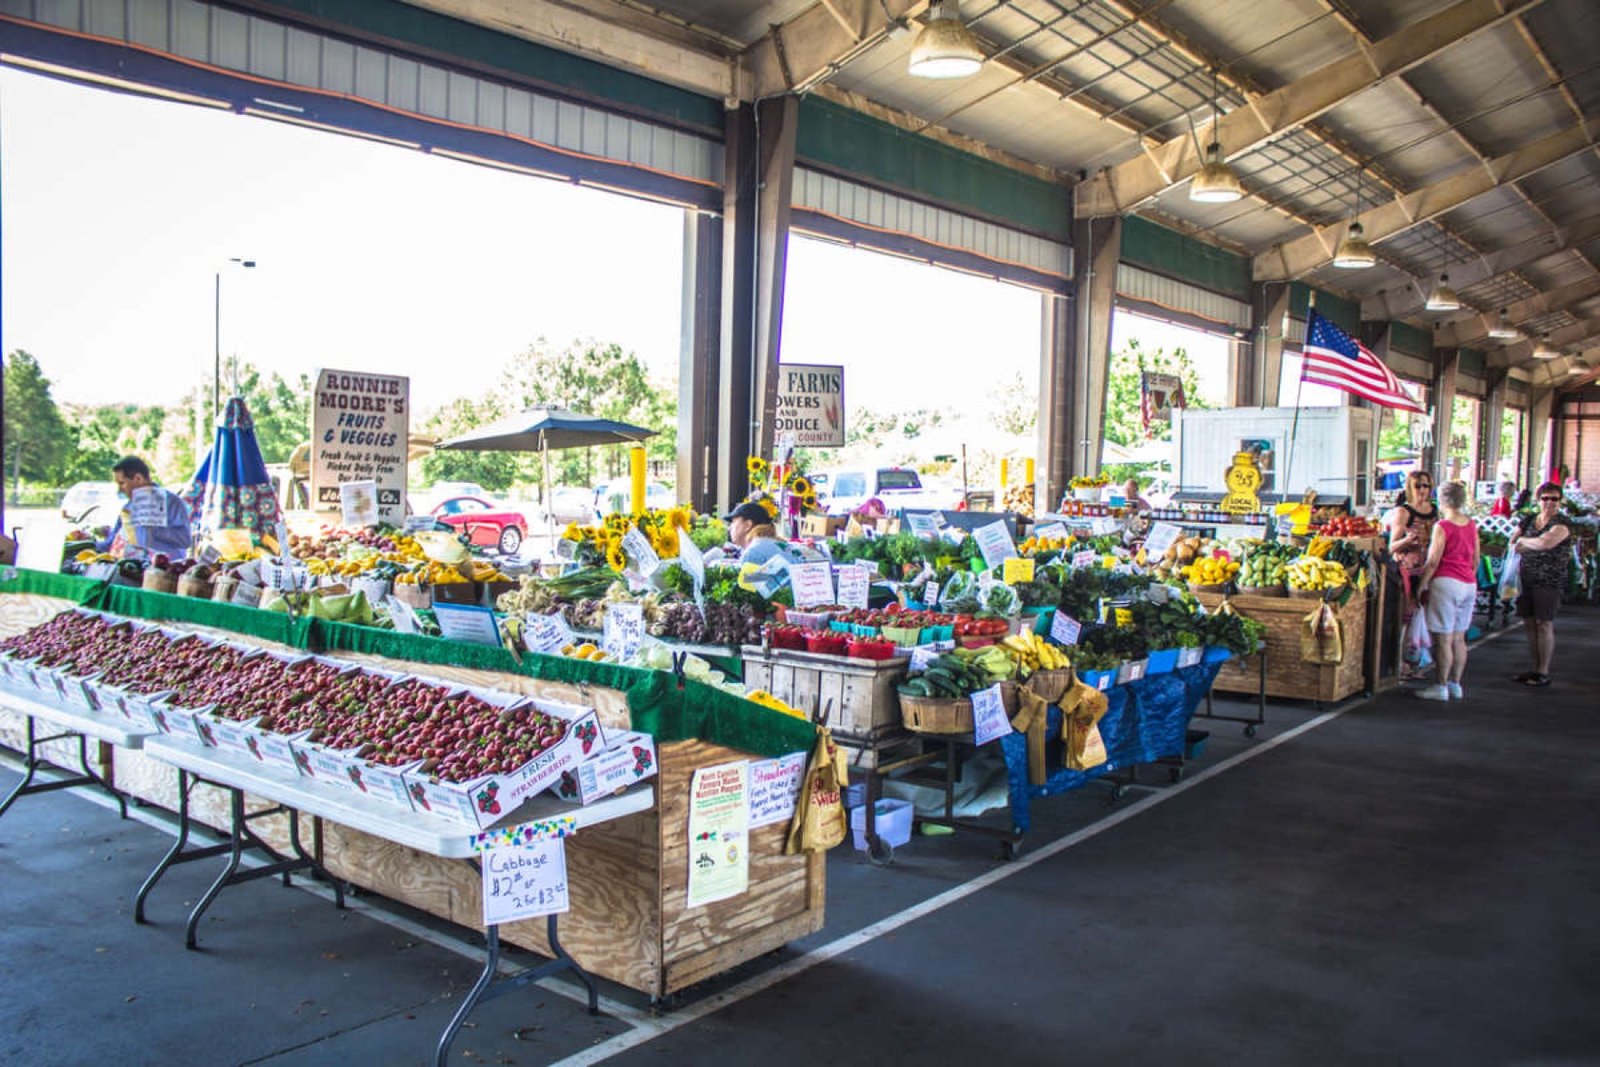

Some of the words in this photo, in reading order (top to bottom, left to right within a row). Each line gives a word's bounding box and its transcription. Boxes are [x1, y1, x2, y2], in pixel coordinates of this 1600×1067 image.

[326, 373, 399, 395] RONNIE
[788, 372, 840, 394] FARMS
[320, 392, 404, 414] MOORE'S
[776, 394, 820, 408] OWERS
[337, 412, 385, 430] FRUITS
[779, 409, 798, 417] AND
[775, 418, 820, 431] ODUCE
[340, 430, 398, 447] VEGGIES
[798, 432, 833, 442] COUNTY
[321, 450, 341, 460] Fresh
[344, 451, 362, 461] Fruit
[327, 461, 352, 472] Picked
[354, 462, 374, 474] Daily
[376, 464, 395, 473] From
[522, 750, 557, 780] FRESH
[510, 753, 573, 800] STRAWBERRIES
[489, 853, 550, 873] Cabbage
